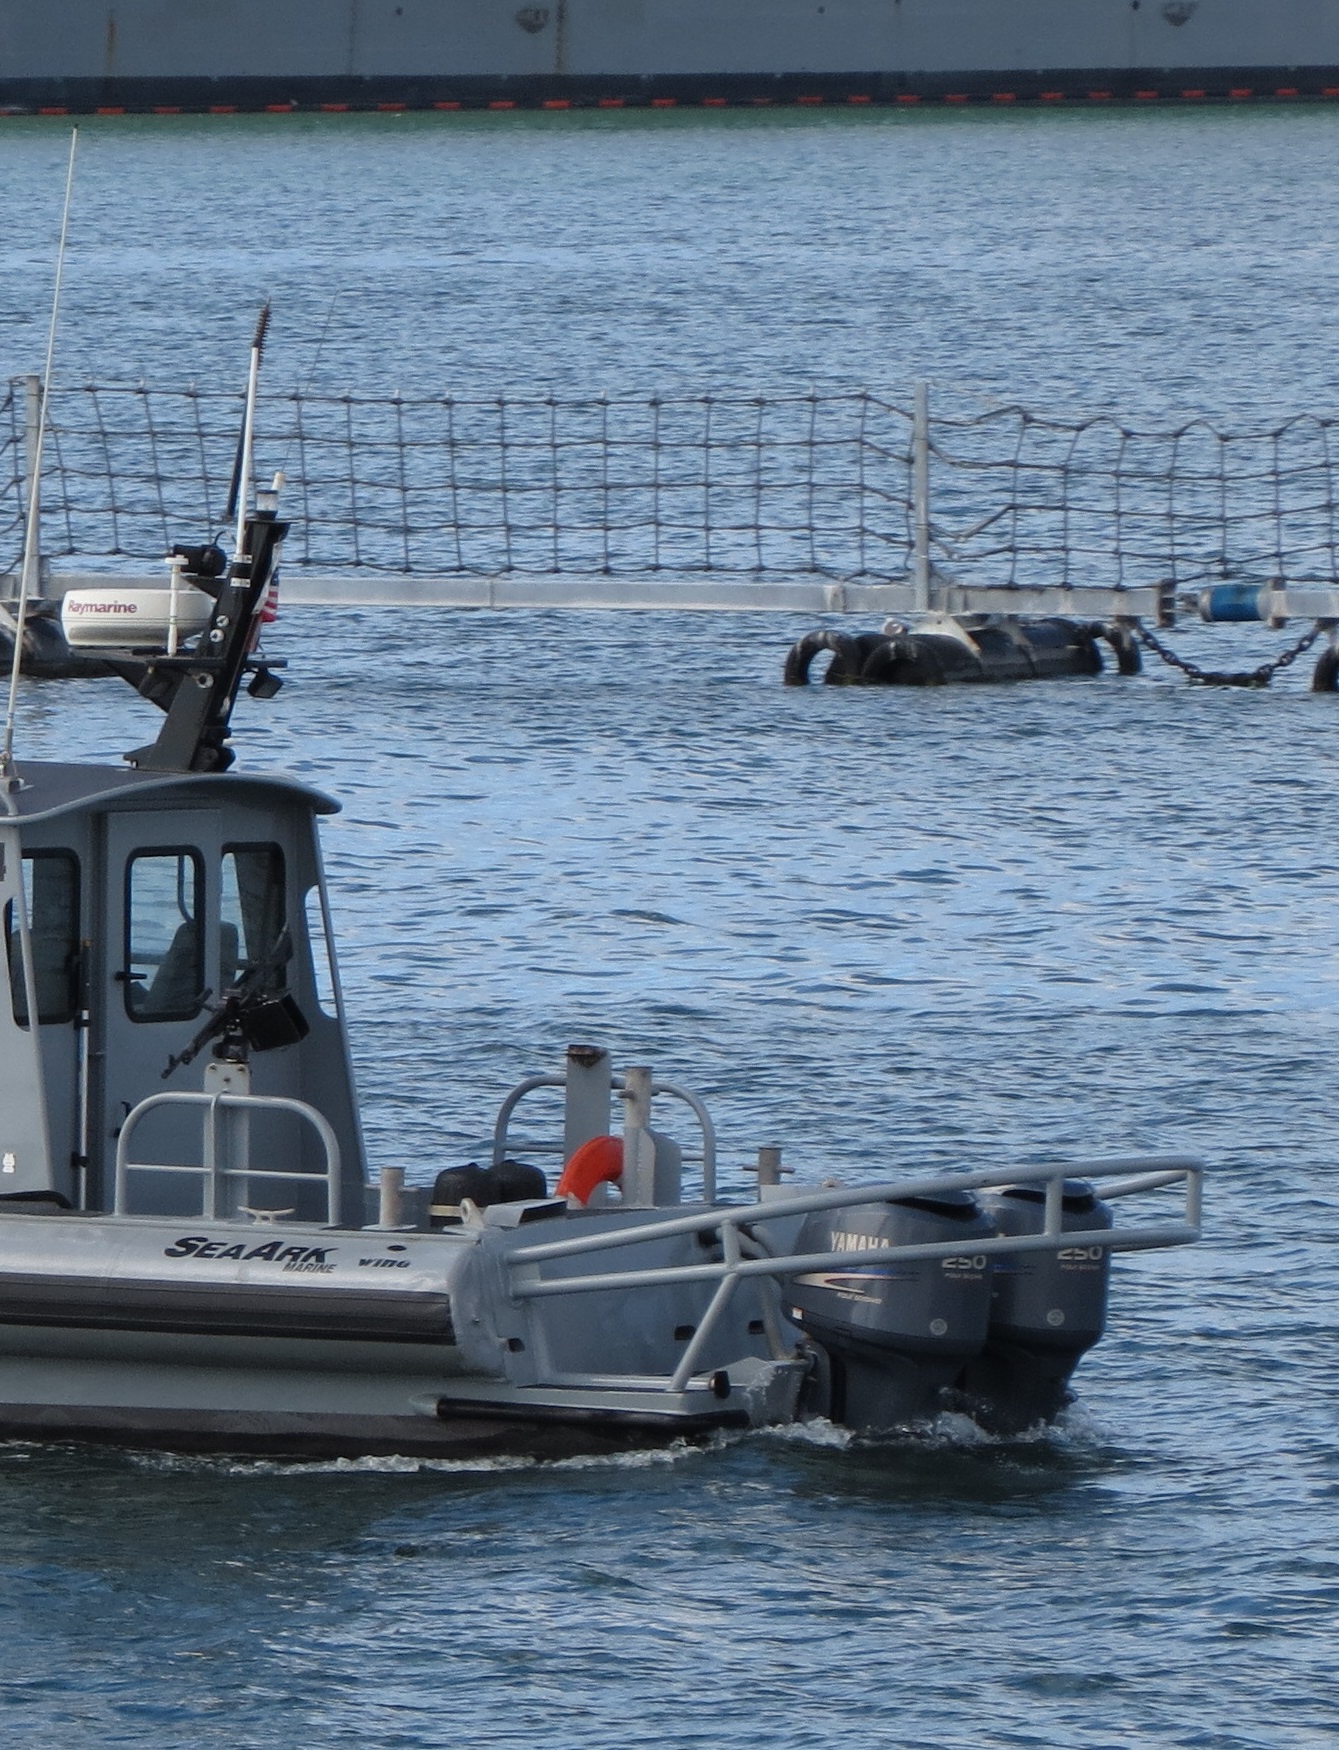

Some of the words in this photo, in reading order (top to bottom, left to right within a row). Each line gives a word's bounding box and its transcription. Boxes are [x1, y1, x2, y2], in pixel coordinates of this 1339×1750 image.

[68, 600, 137, 615] Raymarine
[1057, 1246, 1103, 1260] 250
[282, 1262, 337, 1273] MARINE
[941, 1254, 987, 1270] 250
